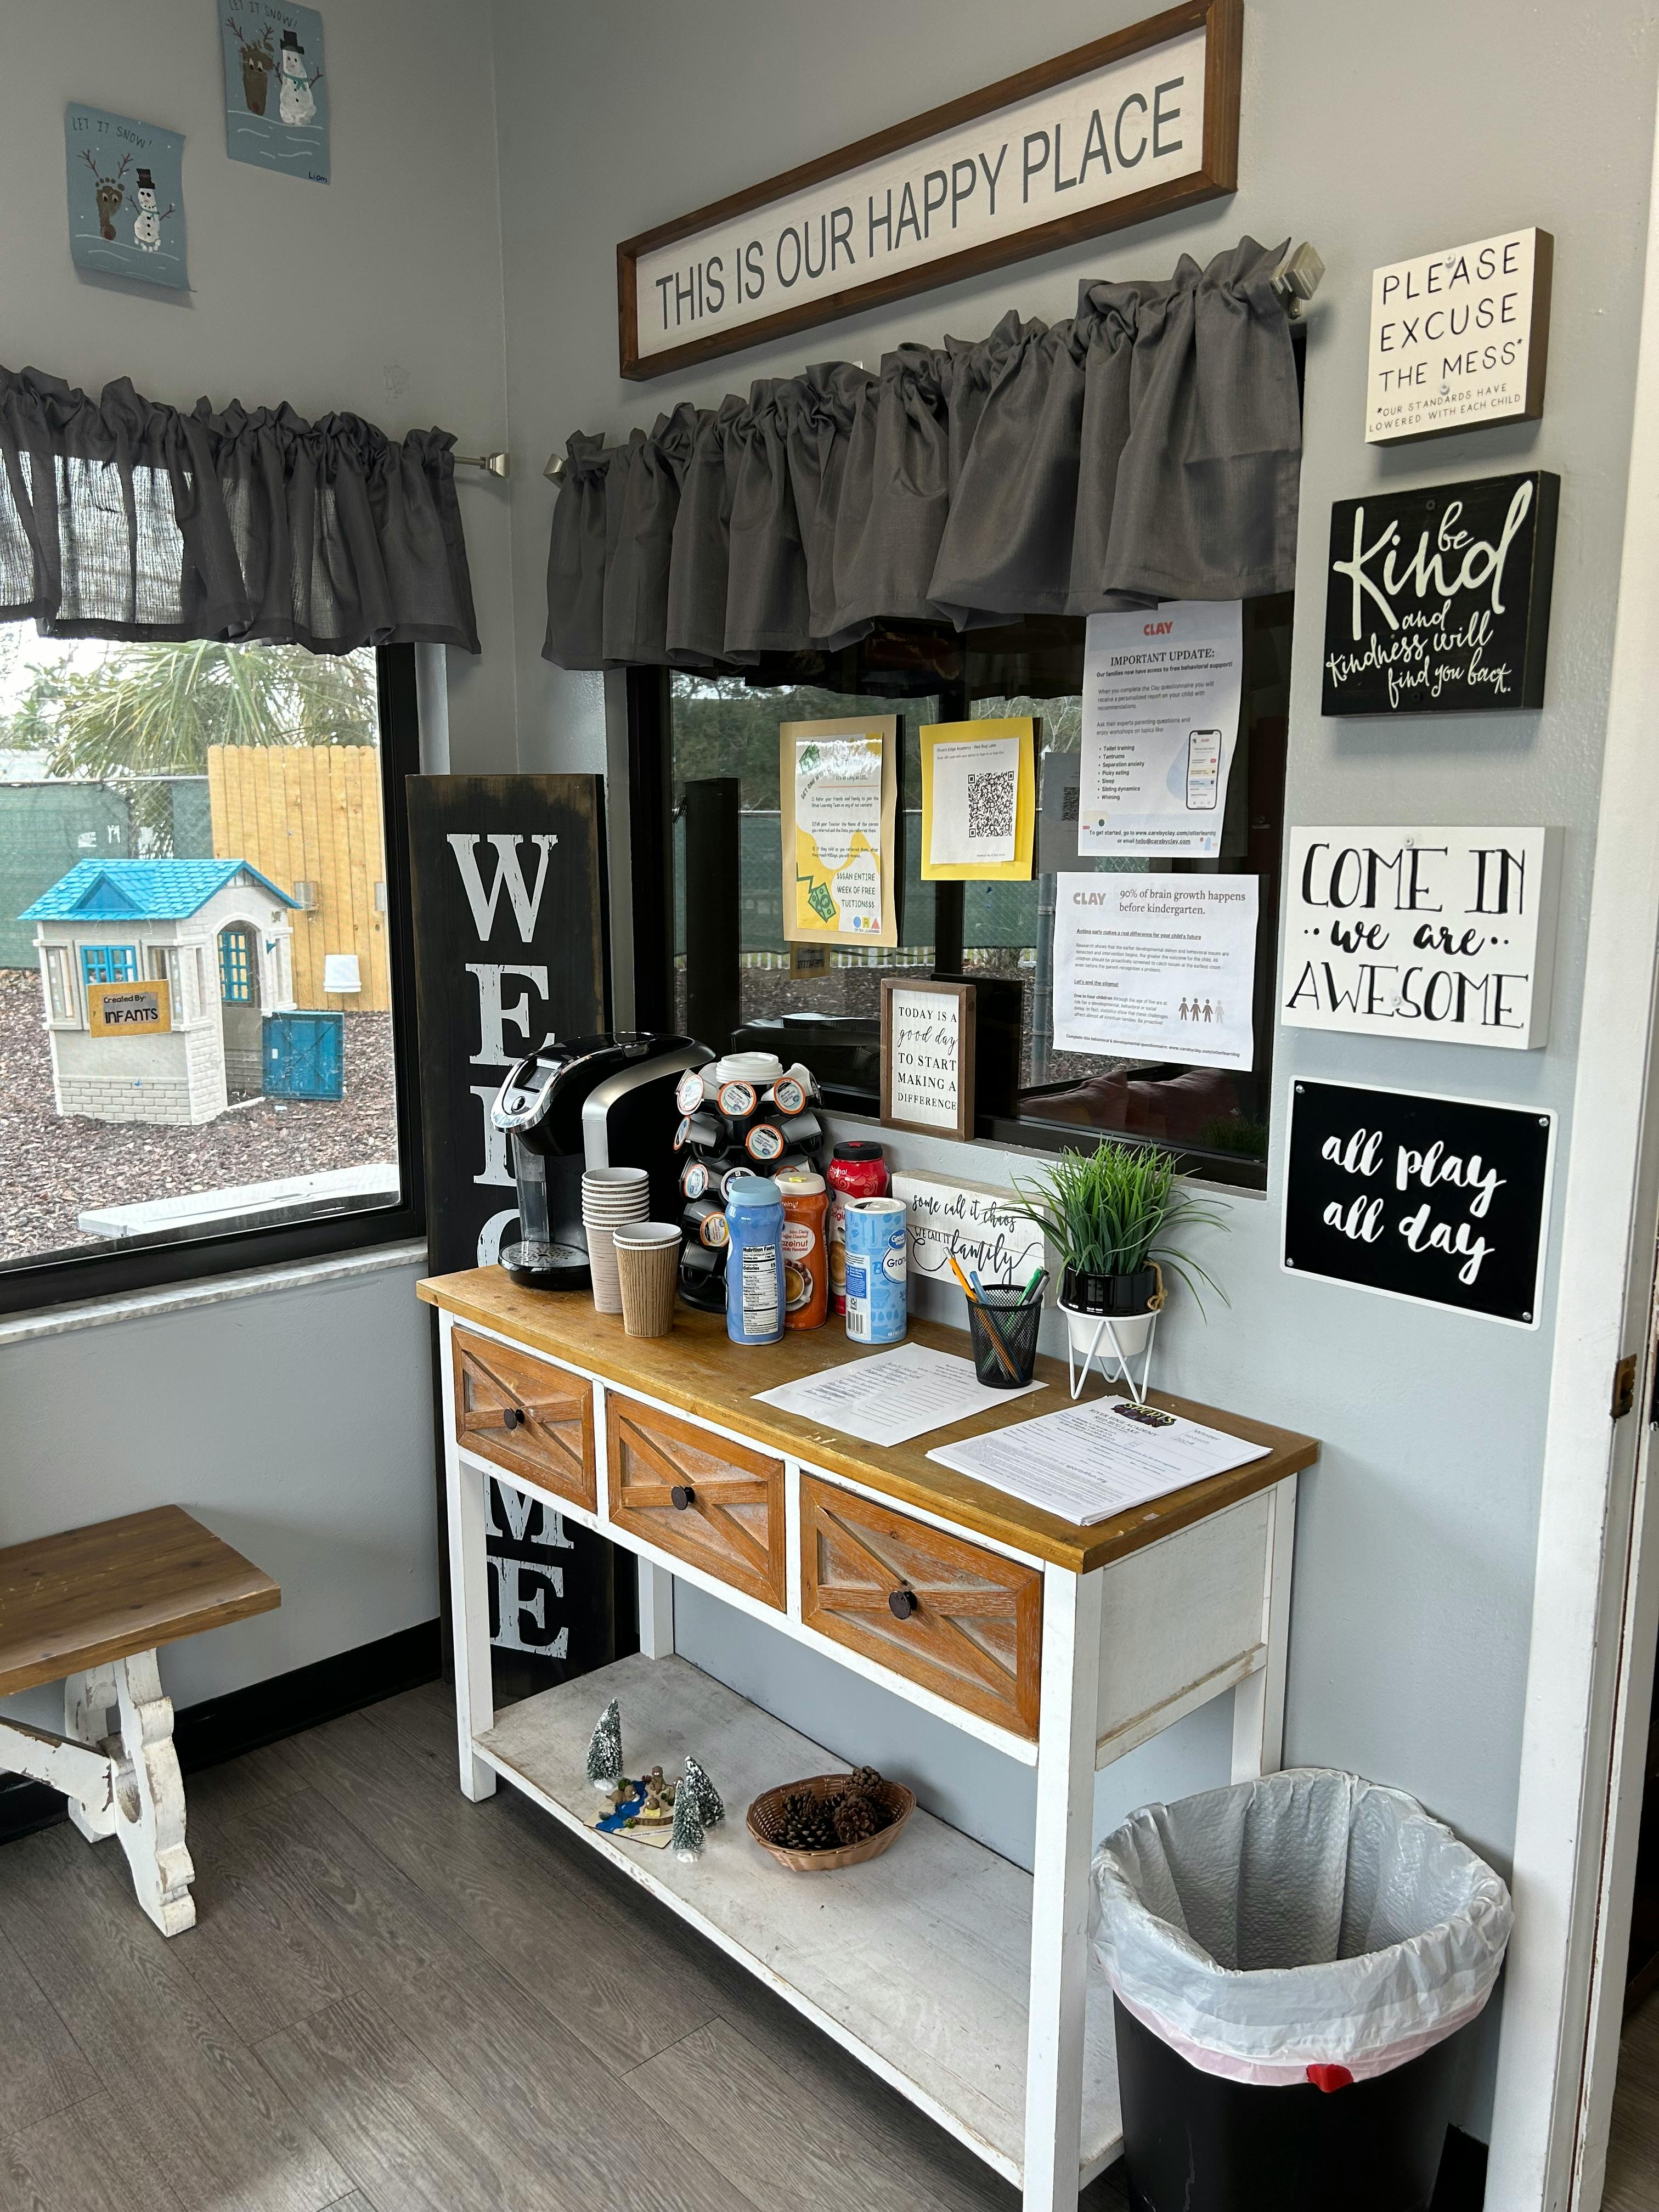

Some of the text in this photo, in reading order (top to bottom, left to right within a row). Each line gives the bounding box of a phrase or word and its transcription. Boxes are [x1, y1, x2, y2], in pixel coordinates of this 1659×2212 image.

[250, 1, 261, 14] IT
[265, 5, 298, 27] SNOW!
[71, 117, 153, 148] LET IT SNOW!
[308, 172, 328, 183] Liam
[656, 76, 1185, 330] THIS IS OUR HAPPY PLACE
[1383, 241, 1520, 305] PLEASE
[1380, 292, 1518, 352] EXCUSE
[1379, 362, 1428, 392] THE
[1408, 390, 1471, 413] STANDARDS
[1477, 383, 1508, 398] HAVE
[1369, 394, 1520, 432] LOWERED WITH EACH CHILD
[1437, 501, 1475, 551] be
[1333, 480, 1533, 641] Kind
[1143, 621, 1173, 636] CLAY
[1402, 599, 1452, 631] and
[1433, 610, 1494, 651] will
[1110, 648, 1215, 667] IMPORTANT UPDATE:
[1181, 662, 1209, 671] behavioral
[1387, 655, 1430, 709] find
[1431, 663, 1465, 697] you
[807, 779, 816, 789] ONE
[854, 873, 876, 881] ENTIRE
[1301, 842, 1526, 916] COME IN
[841, 899, 874, 909] TUITION$$$
[1073, 892, 1107, 905] CLAY
[1119, 902, 1206, 916] before kindergarten.
[1120, 889, 1246, 903] 90% of brain growth happens
[104, 995, 133, 1003] Created
[1285, 960, 1529, 1029] AWESOME
[898, 1006, 957, 1022] TODAY IS A
[897, 1026, 959, 1056] good day
[898, 1052, 957, 1071] TO START
[898, 1072, 957, 1092] MAKING A
[898, 1092, 957, 1110] DIFFERENCE
[1322, 1128, 1508, 1218] all play
[912, 1194, 1017, 1233] some call it chaos
[891, 1232, 905, 1243] Great
[1323, 1197, 1496, 1285] all day
[914, 1227, 1027, 1285] WE CALL IT family
[1123, 1403, 1173, 1423] SPORTS
[1194, 1429, 1221, 1441] Winter
